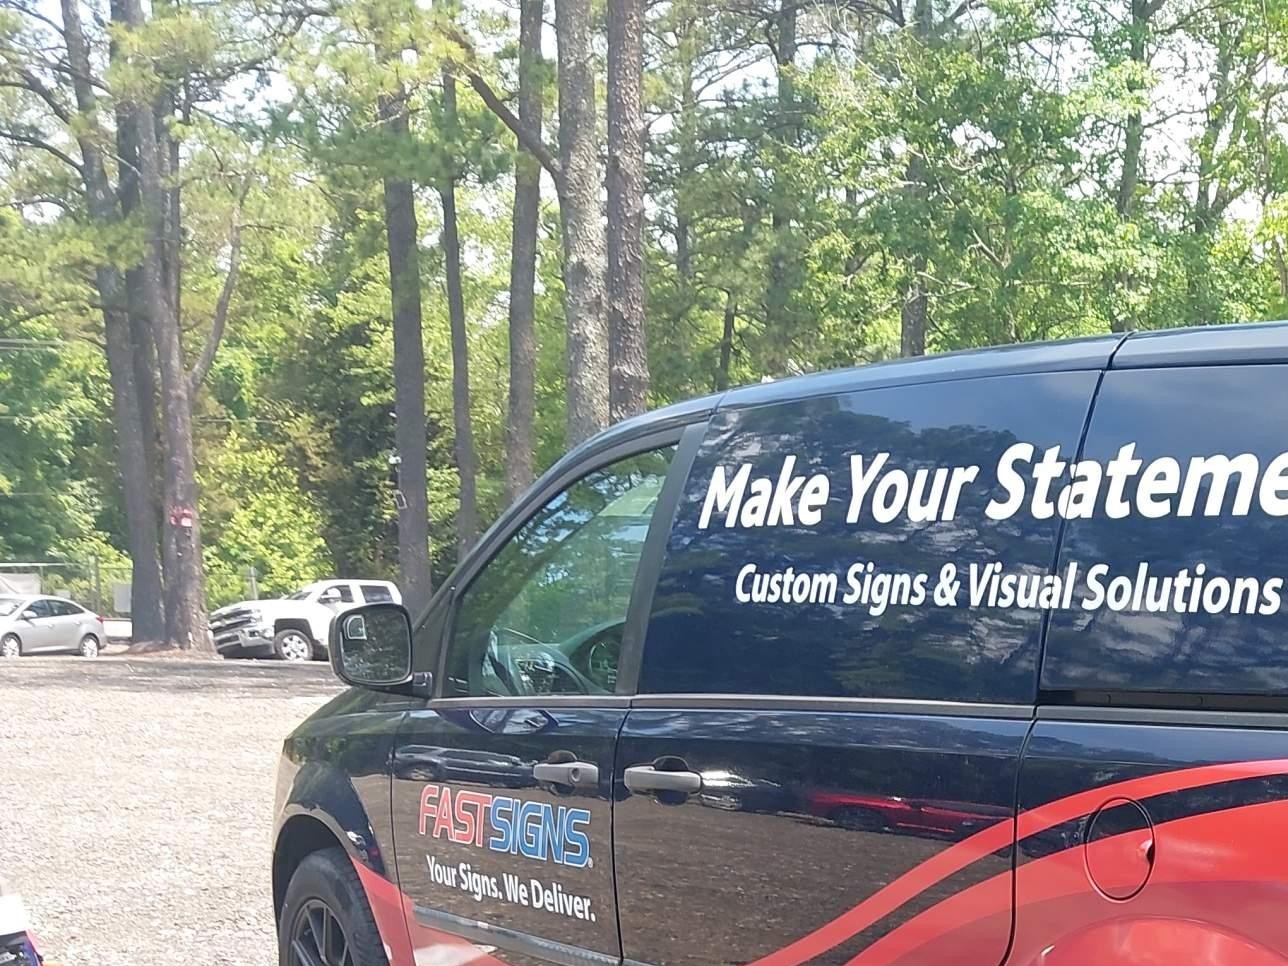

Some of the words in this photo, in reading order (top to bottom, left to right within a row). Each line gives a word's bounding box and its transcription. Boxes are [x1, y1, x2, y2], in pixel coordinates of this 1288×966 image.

[699, 455, 831, 529] Make
[845, 452, 980, 524] Your
[735, 564, 838, 604] Custom
[843, 564, 927, 617] Signs
[934, 567, 961, 604] &
[968, 562, 1073, 610] Visual
[1085, 565, 1284, 616] Solutions
[426, 855, 457, 888] Your
[459, 862, 503, 901] Signs.
[503, 873, 528, 906] We
[531, 879, 596, 922] Deliver.
